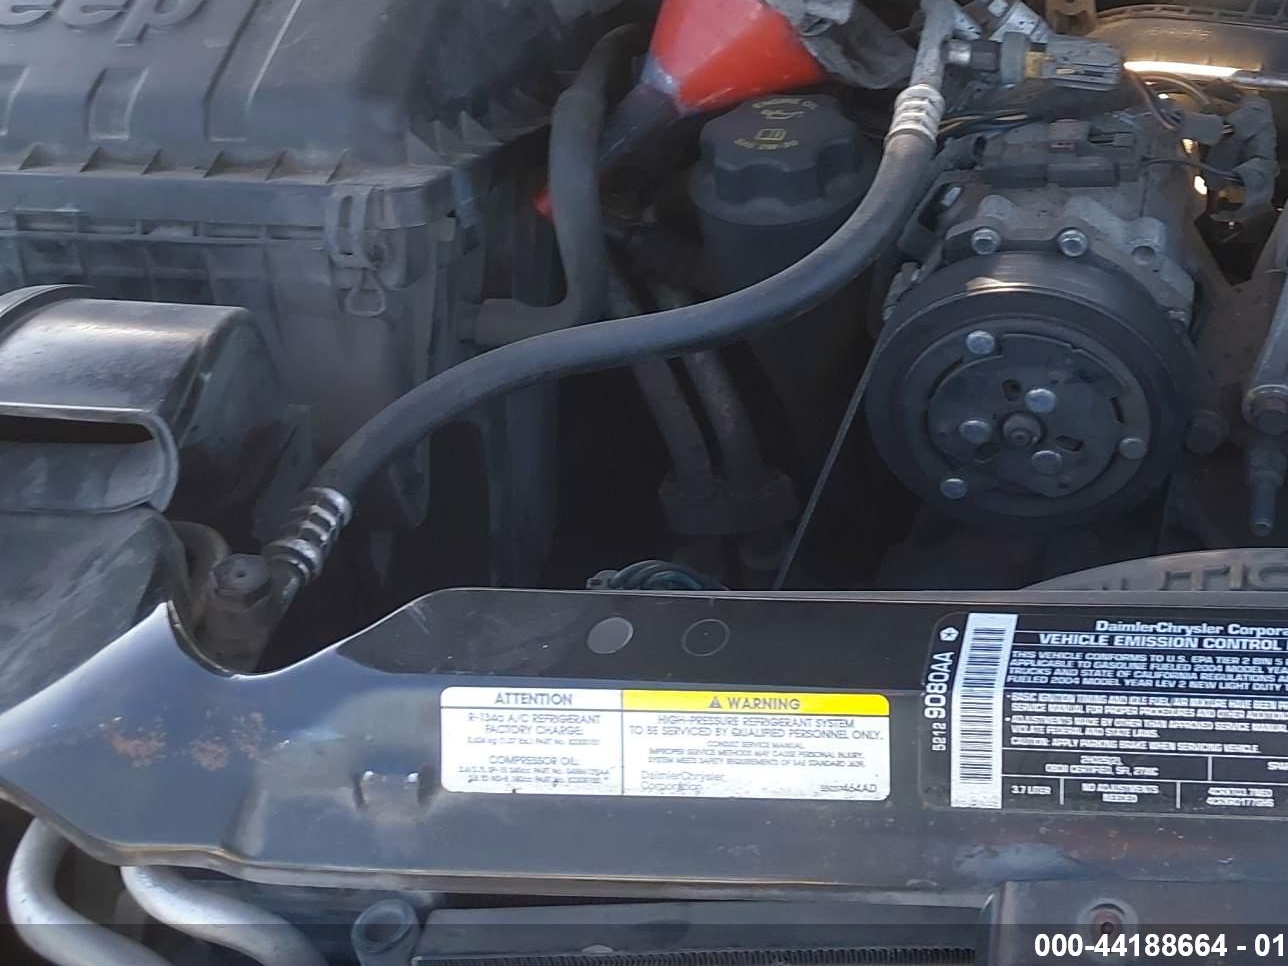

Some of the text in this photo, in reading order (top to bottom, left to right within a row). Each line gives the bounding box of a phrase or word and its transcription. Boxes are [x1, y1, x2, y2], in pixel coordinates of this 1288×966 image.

[1095, 620, 1223, 636] DaimlerChrysler
[1039, 633, 1108, 646] VEHICLE
[1113, 635, 1197, 648] EMISSION
[1202, 638, 1281, 650] CONTROL
[1009, 657, 1074, 667] APPLICABLE
[1077, 660, 1090, 668] TO
[1092, 660, 1146, 670] GASOLINE
[1149, 662, 1190, 671] FUELED
[1193, 663, 1222, 672] 2004
[1225, 664, 1263, 673] MODEL
[1012, 649, 1035, 658] THIS
[1037, 650, 1082, 660] VEHICLE
[1085, 652, 1146, 662] CONFORMS
[1149, 654, 1163, 662] TO
[1166, 654, 1187, 663] U.S.
[1190, 655, 1213, 664] EPA
[1215, 656, 1239, 665] TIER
[1241, 657, 1249, 665] 2
[1252, 657, 1272, 666] BIN
[1009, 666, 1051, 675] TRUCKS
[1052, 667, 1077, 676] AND
[1080, 668, 1113, 677] STATE
[1116, 669, 1131, 678] OF
[1133, 670, 1197, 680] CALIFORNIA
[1199, 672, 1275, 682] REGULATIONS
[924, 651, 957, 720] 9080AA
[1007, 674, 1047, 684] FUELED
[1050, 676, 1079, 685] 2004
[1081, 677, 1120, 686] MODEL
[1123, 678, 1152, 687] YEAR
[1154, 679, 1175, 687] LEV
[1177, 680, 1185, 688] 2
[1188, 680, 1215, 689] NEW
[1218, 681, 1250, 690] LIGHT
[1252, 682, 1281, 691] DUTY
[495, 691, 572, 705] ATTENTION
[728, 696, 801, 711] WARNING
[532, 713, 600, 724] REFRIGERANT
[743, 716, 813, 727] REFRIGERANT
[485, 723, 583, 735] FACTORY CHARGE
[630, 724, 643, 735] TO
[647, 725, 658, 735] BE
[662, 725, 711, 736] SERVICED
[716, 726, 726, 737] BY
[731, 727, 784, 738] QUALIFIED
[788, 728, 848, 740] PERSONNEL
[489, 754, 579, 766] COMPRESSOR OIL
